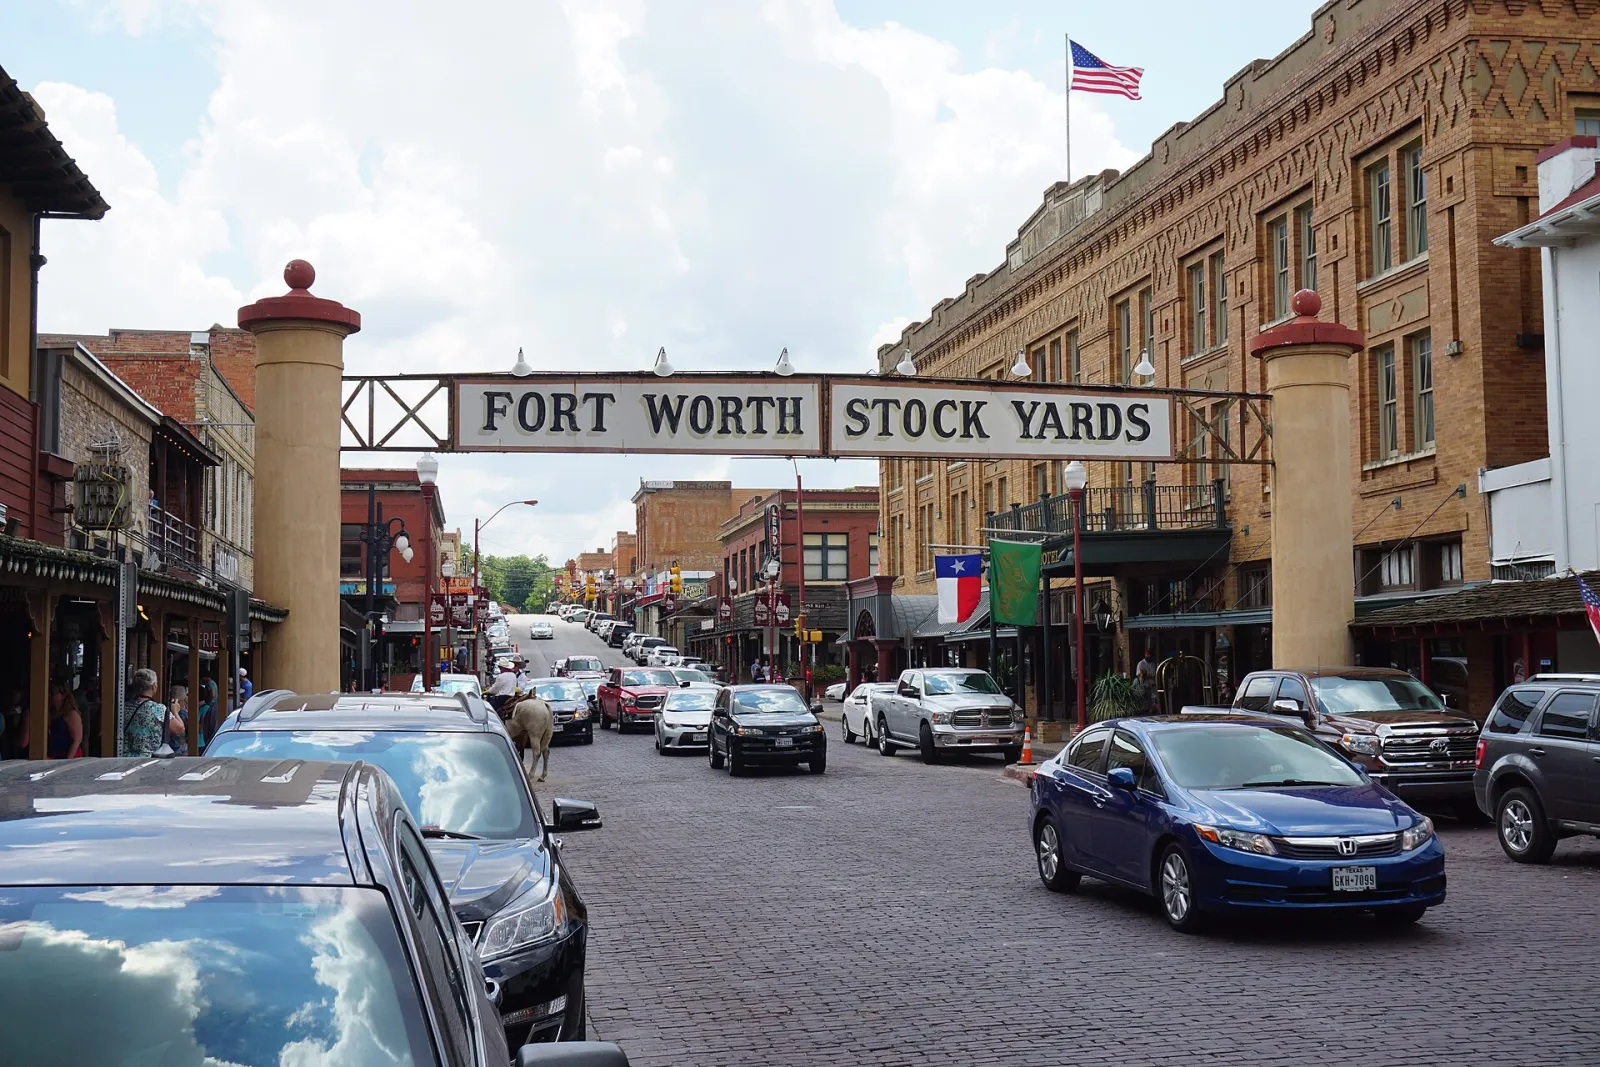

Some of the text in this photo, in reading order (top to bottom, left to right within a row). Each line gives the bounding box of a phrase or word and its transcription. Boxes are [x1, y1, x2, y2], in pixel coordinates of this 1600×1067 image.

[482, 391, 1151, 442] FORT WORTH STOCK YARDS
[1041, 550, 1060, 566] OTEL
